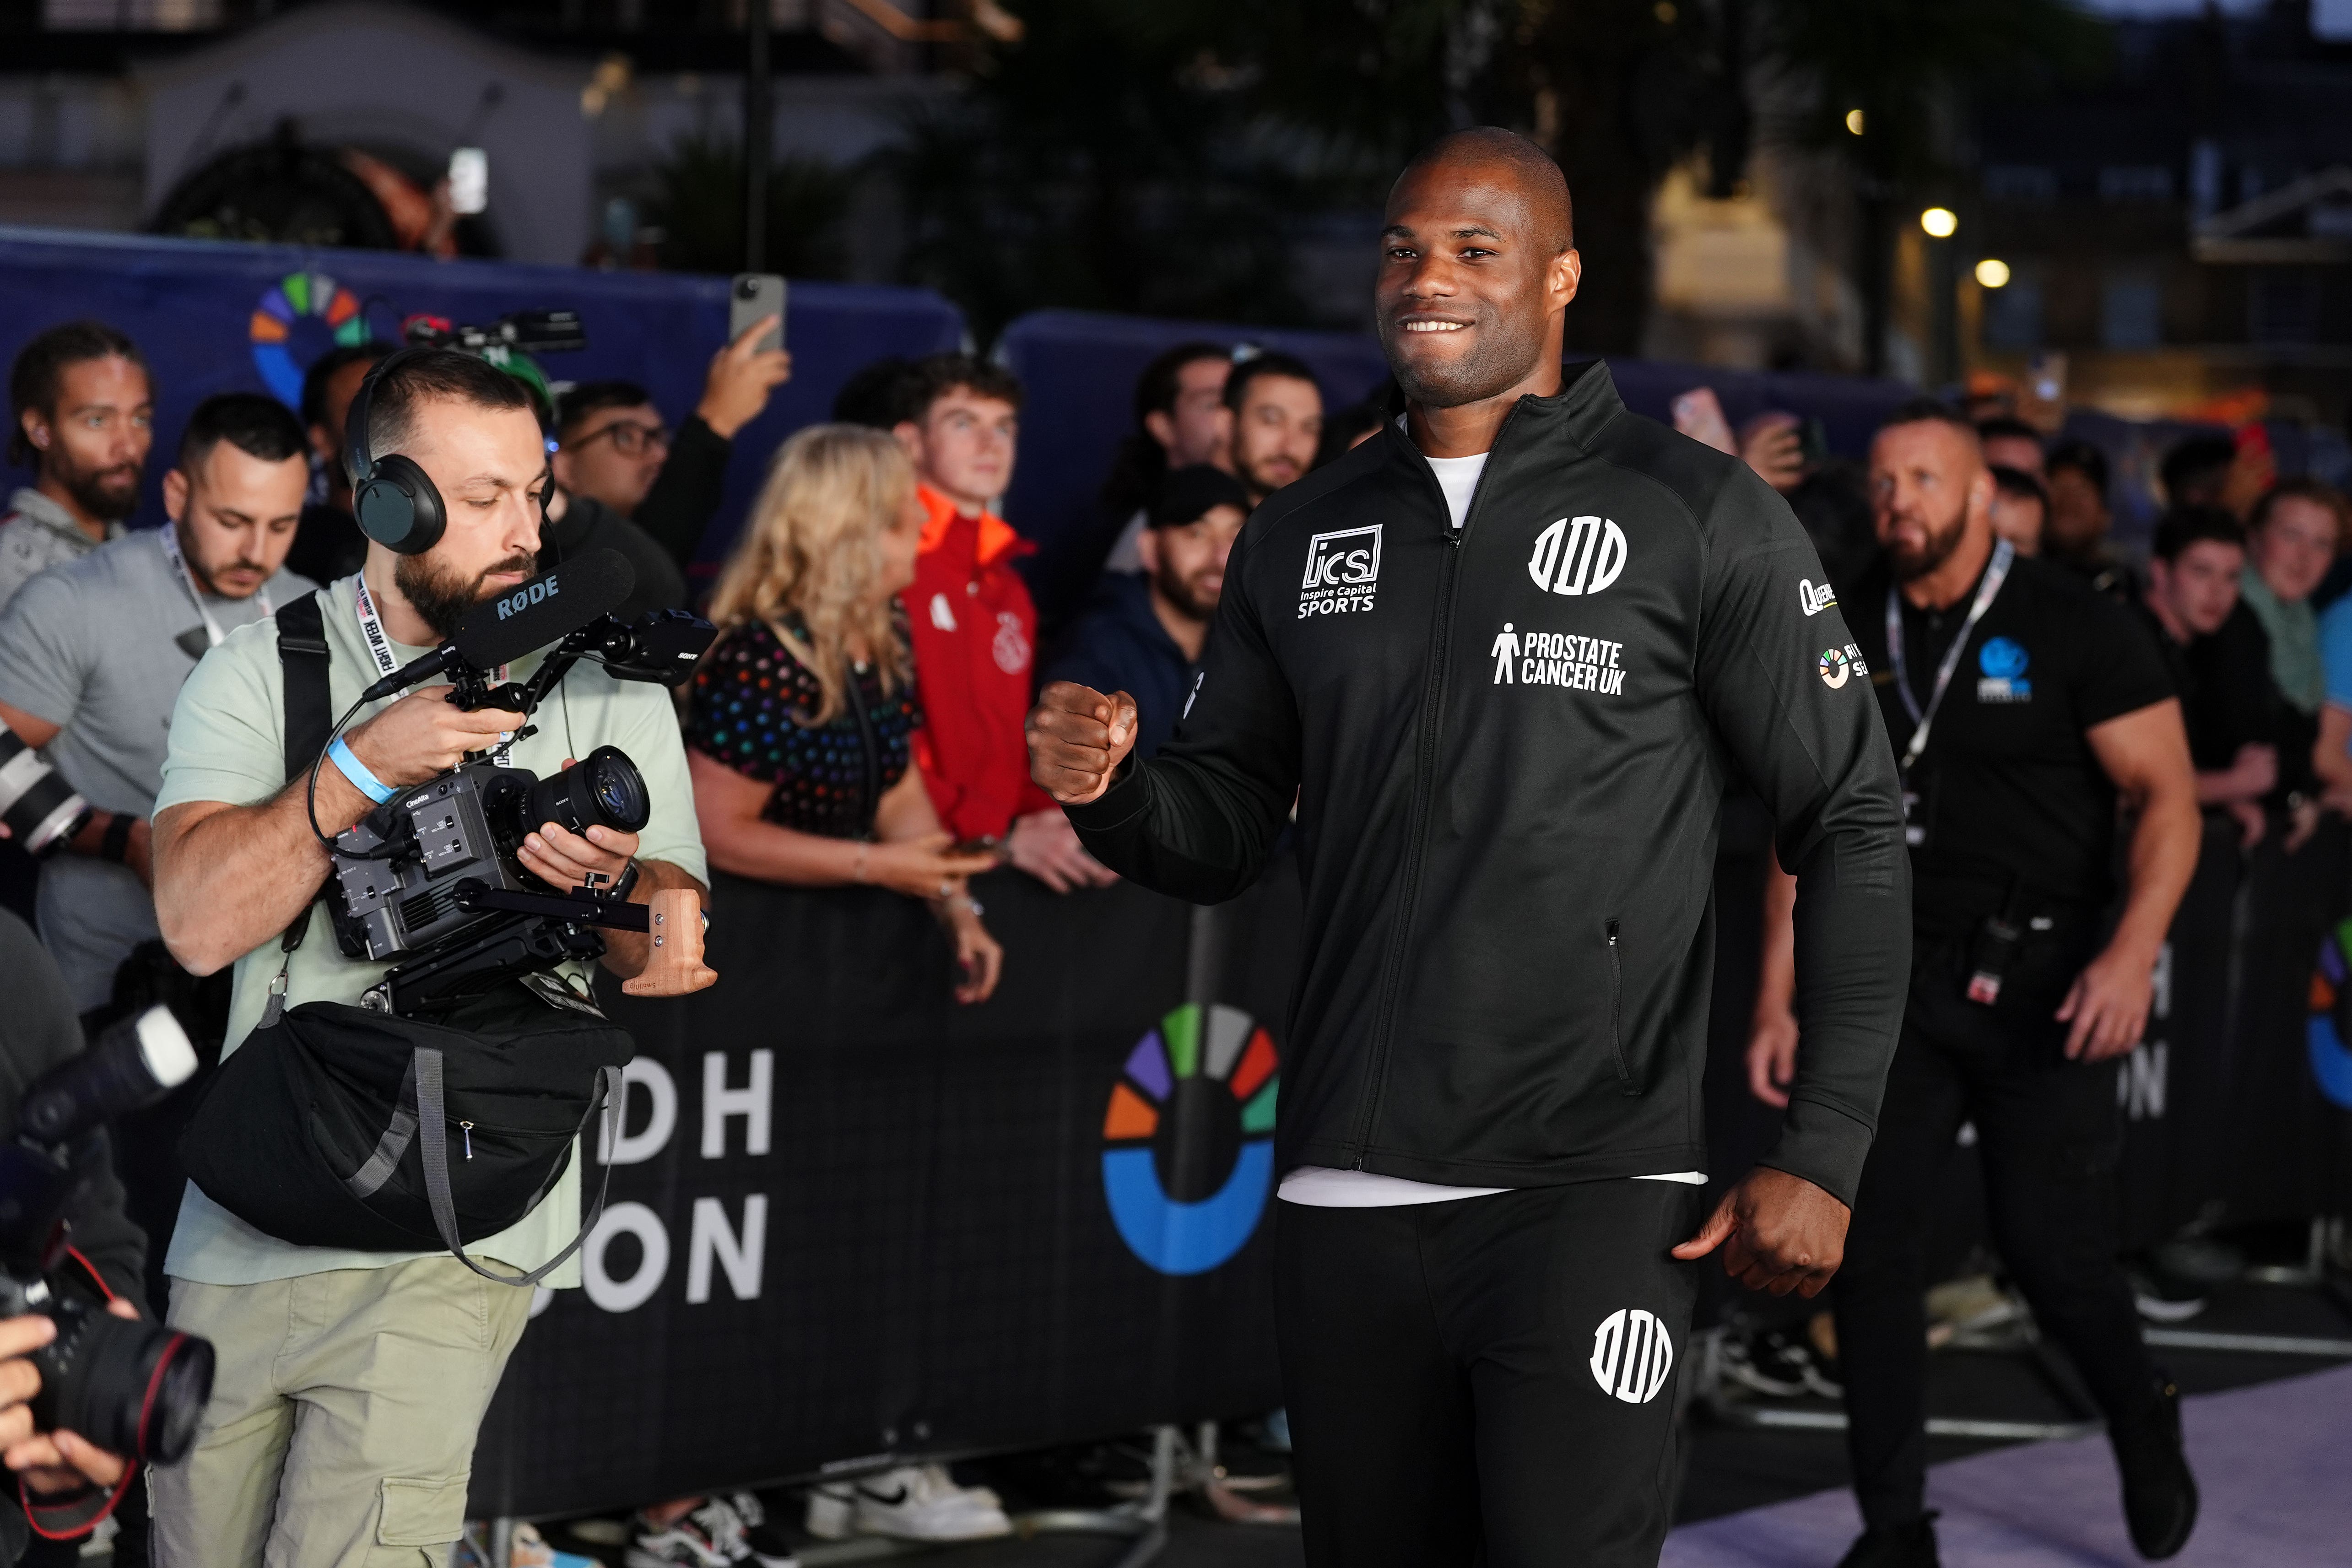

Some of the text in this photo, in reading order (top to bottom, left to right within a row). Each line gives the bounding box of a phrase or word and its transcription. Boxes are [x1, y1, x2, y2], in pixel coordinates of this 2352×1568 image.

[497, 575, 559, 621] RØDE
[1298, 595, 1374, 619] SPORTS
[1300, 583, 1376, 601] Inspire Capital
[363, 618, 395, 671] FIGHT WEEK
[1524, 633, 1623, 669] PROSTATE
[1844, 643, 1862, 659] RIY
[1521, 658, 1626, 696] CANCER UK
[406, 794, 429, 808] CineAlta
[630, 982, 656, 990] SmallRig
[528, 1192, 769, 1320] ON
